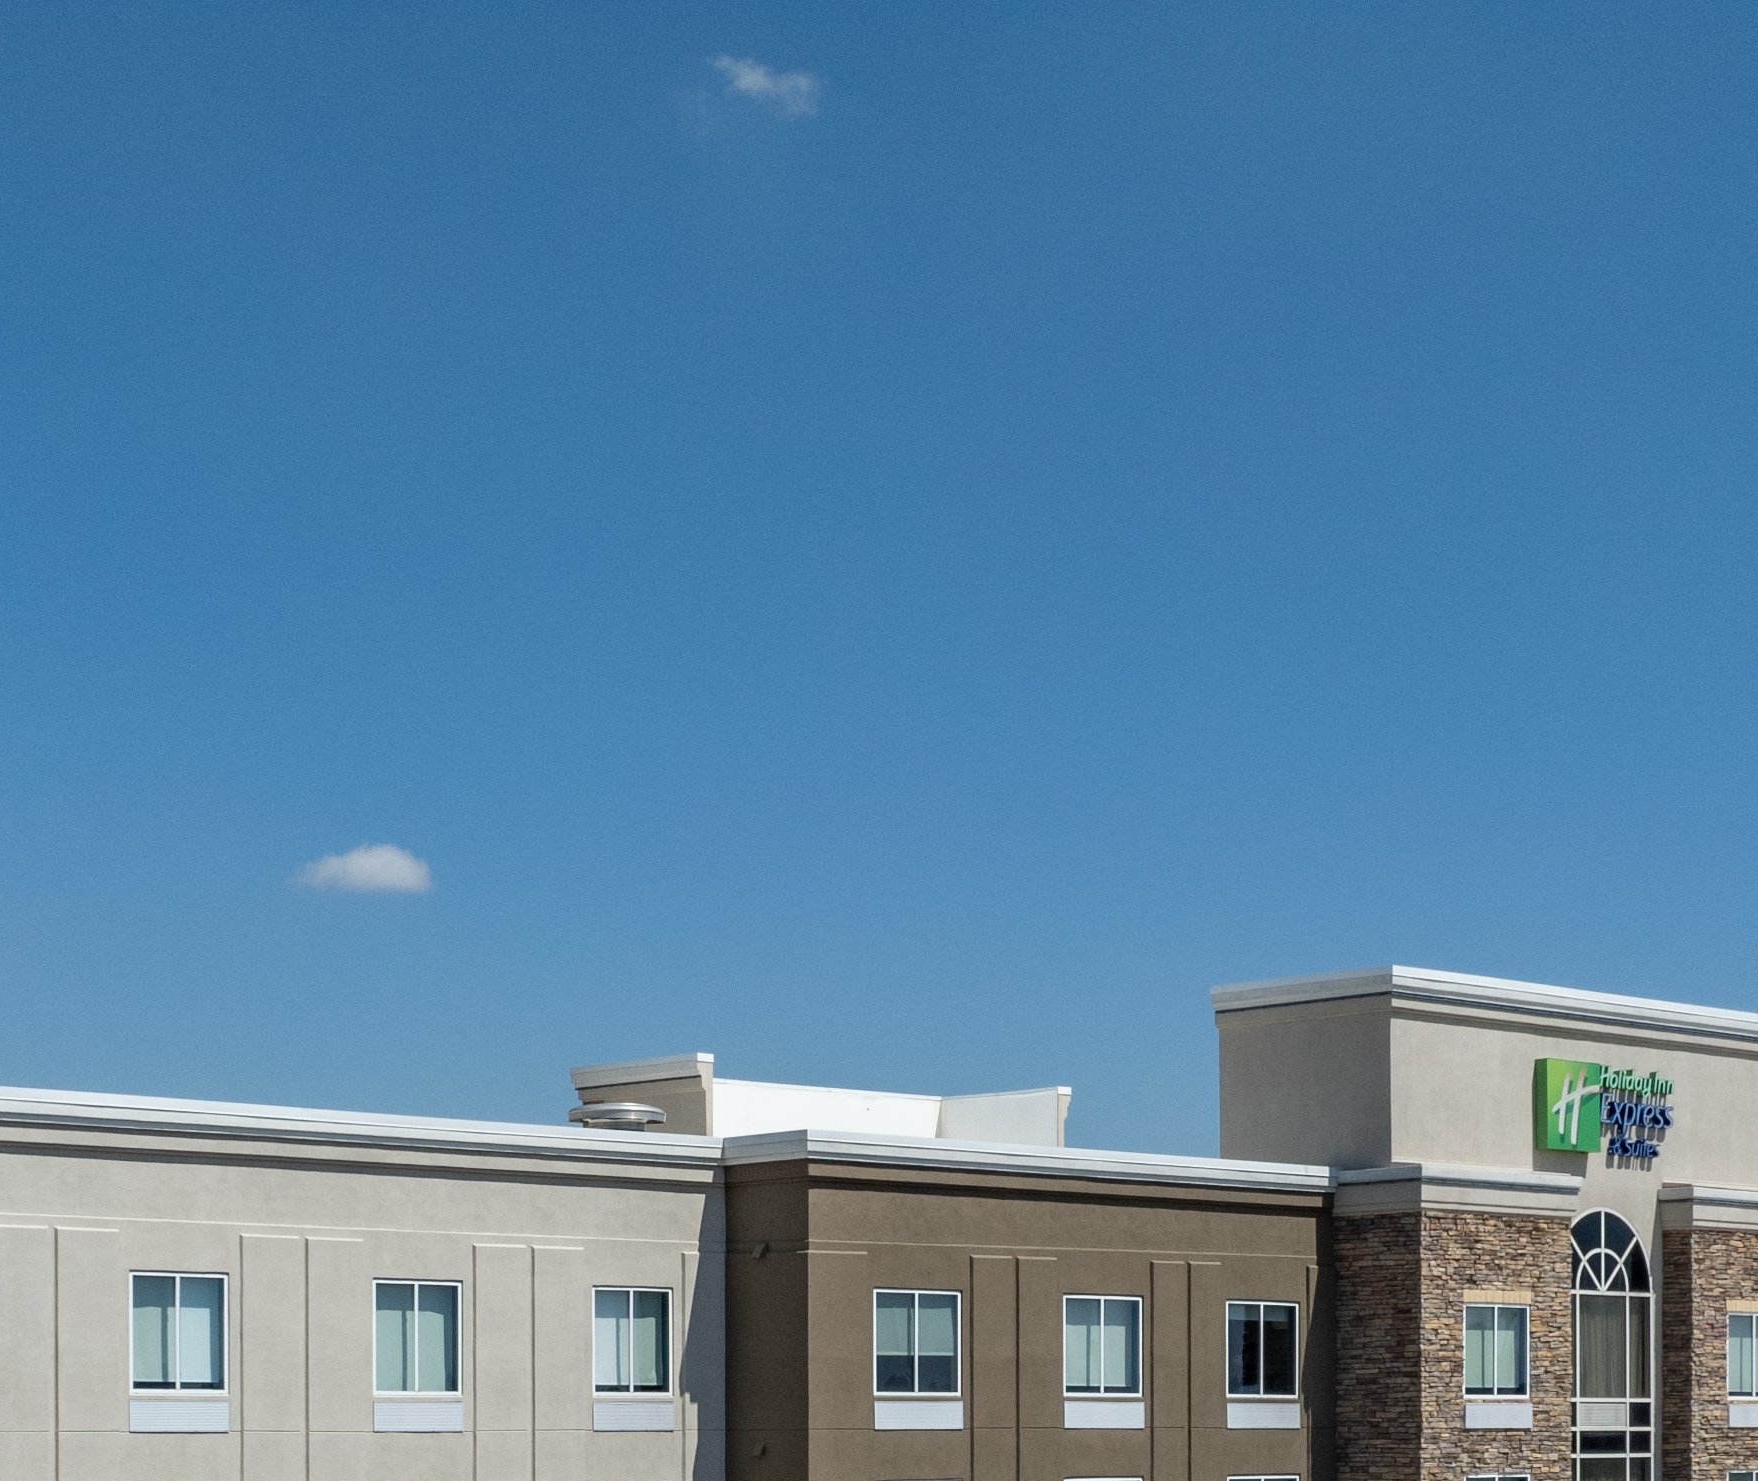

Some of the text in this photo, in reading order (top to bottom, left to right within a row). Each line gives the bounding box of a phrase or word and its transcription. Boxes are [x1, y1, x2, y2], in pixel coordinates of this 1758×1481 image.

[1601, 1066, 1674, 1097] Holiday Inn
[1601, 1093, 1674, 1138] Express
[1624, 1138, 1660, 1158] Suites
